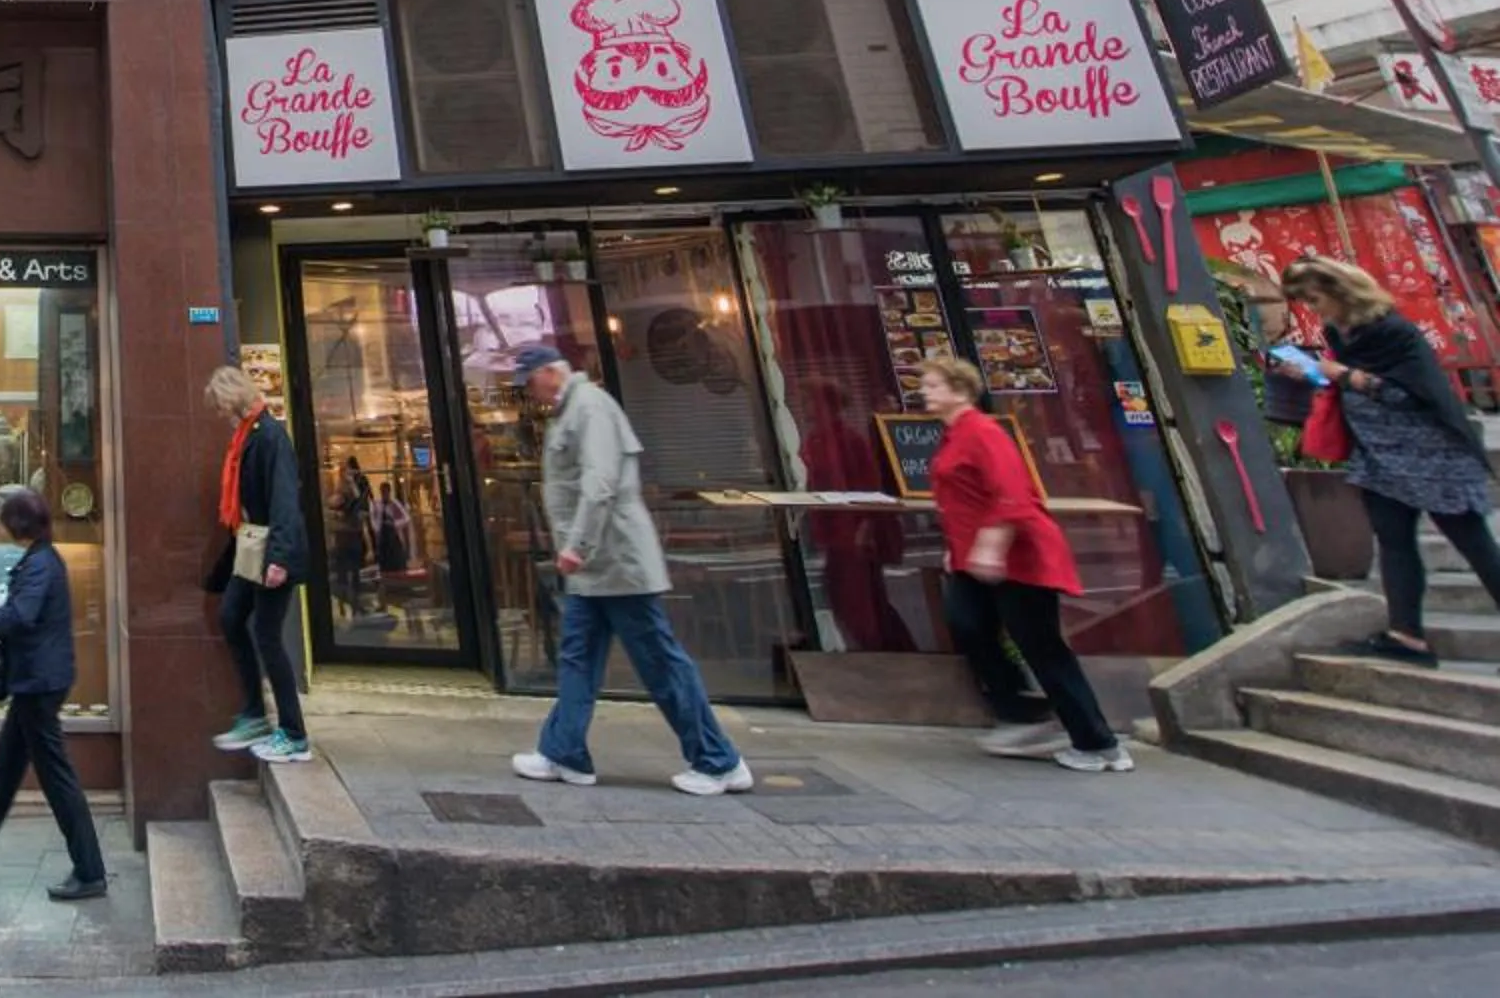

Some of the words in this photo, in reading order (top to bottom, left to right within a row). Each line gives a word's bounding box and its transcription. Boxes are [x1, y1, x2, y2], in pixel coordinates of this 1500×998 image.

[281, 47, 336, 86] La
[958, 20, 1132, 83] Grande
[1189, 33, 1276, 99] RESTAURANT
[240, 73, 375, 125] Grande
[983, 64, 1141, 118] Bouffe
[257, 111, 373, 159] Bouffe
[22, 258, 89, 281] Arts
